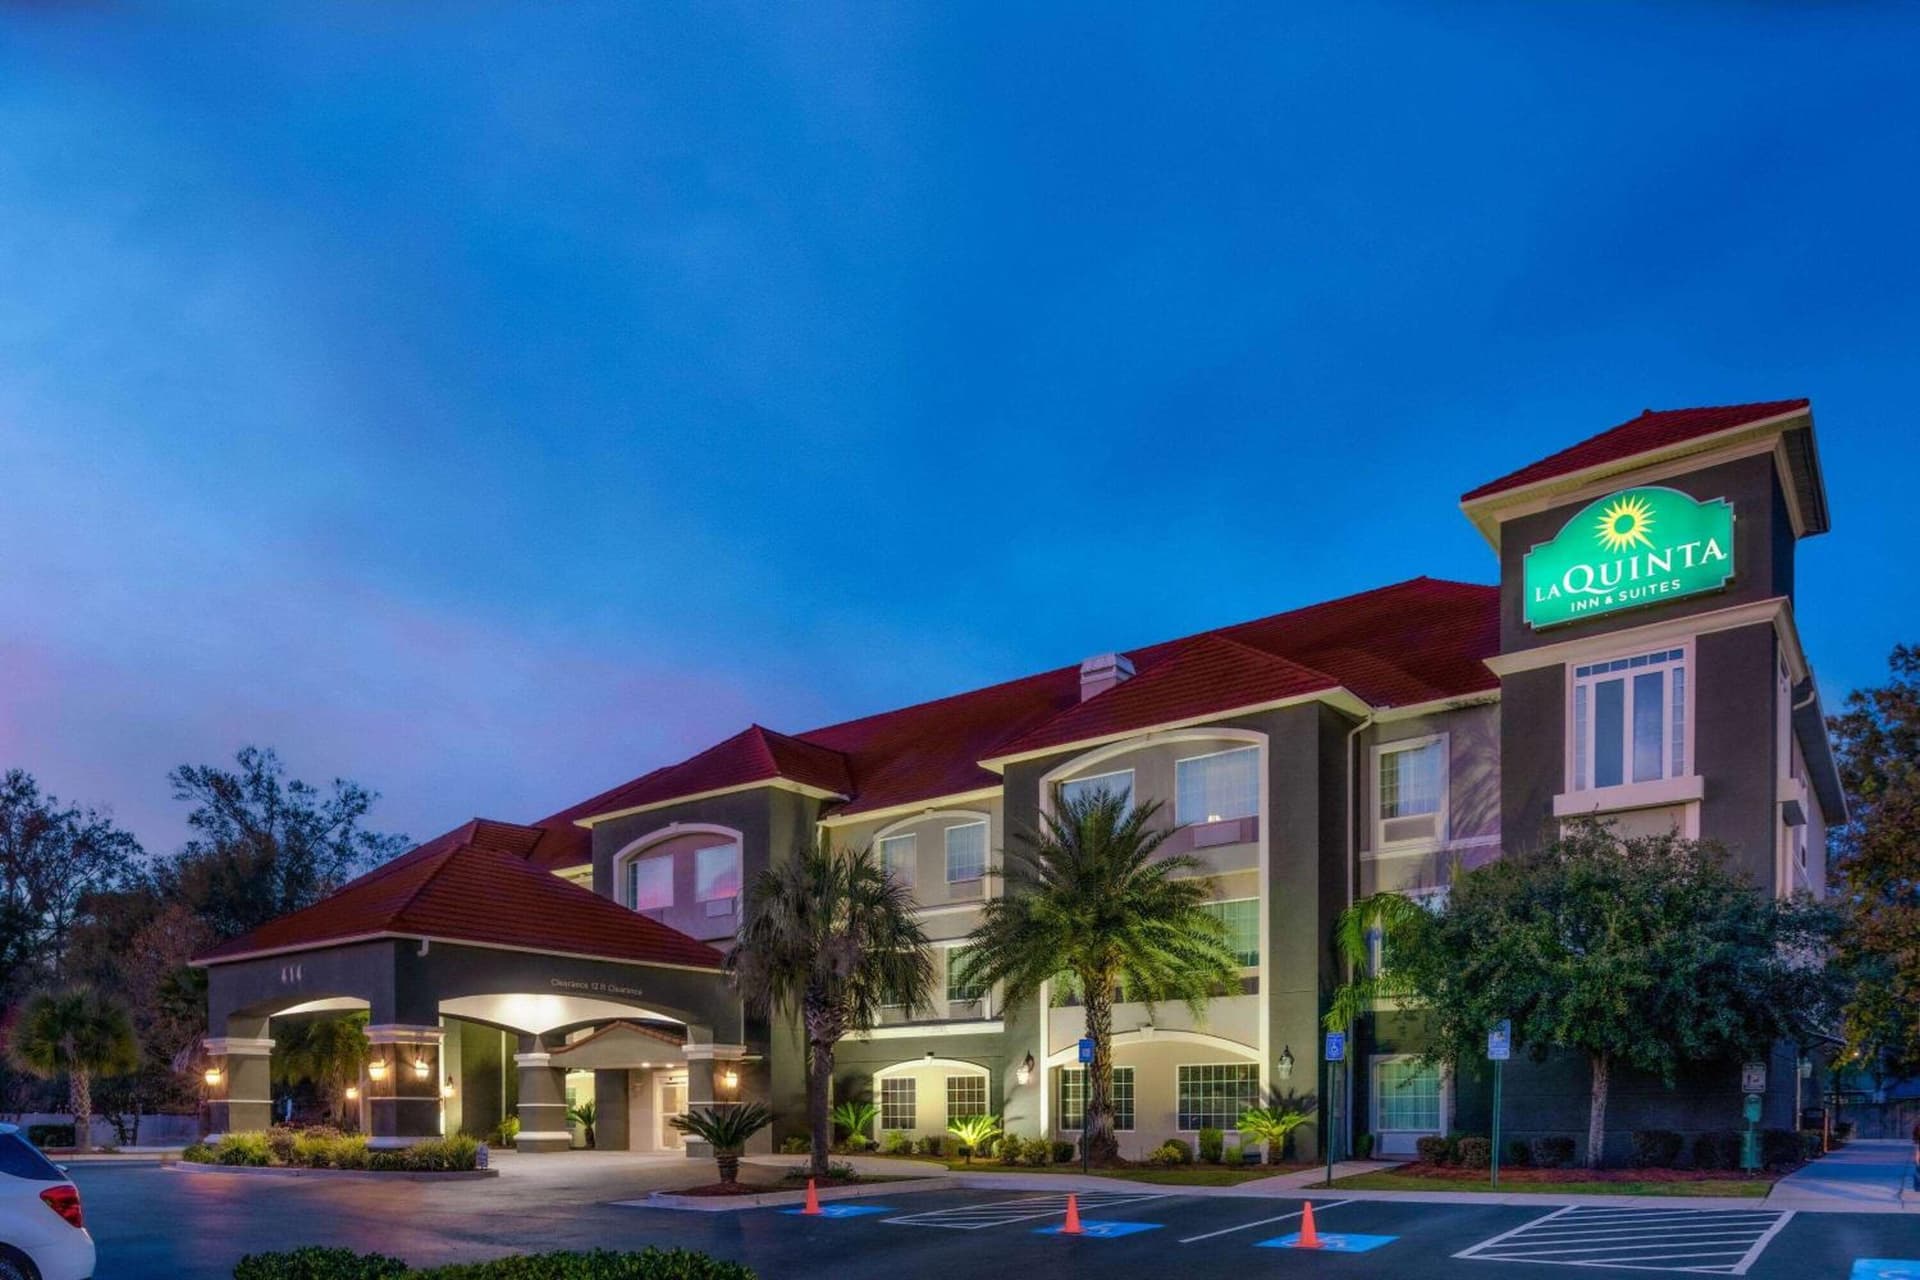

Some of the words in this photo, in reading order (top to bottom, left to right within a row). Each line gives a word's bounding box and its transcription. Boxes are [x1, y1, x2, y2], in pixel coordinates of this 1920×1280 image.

[1535, 583, 1561, 603] LA
[1563, 537, 1728, 595] QUINTA
[1571, 595, 1600, 612] INN
[1605, 595, 1613, 605] &
[1618, 579, 1681, 602] SUITES
